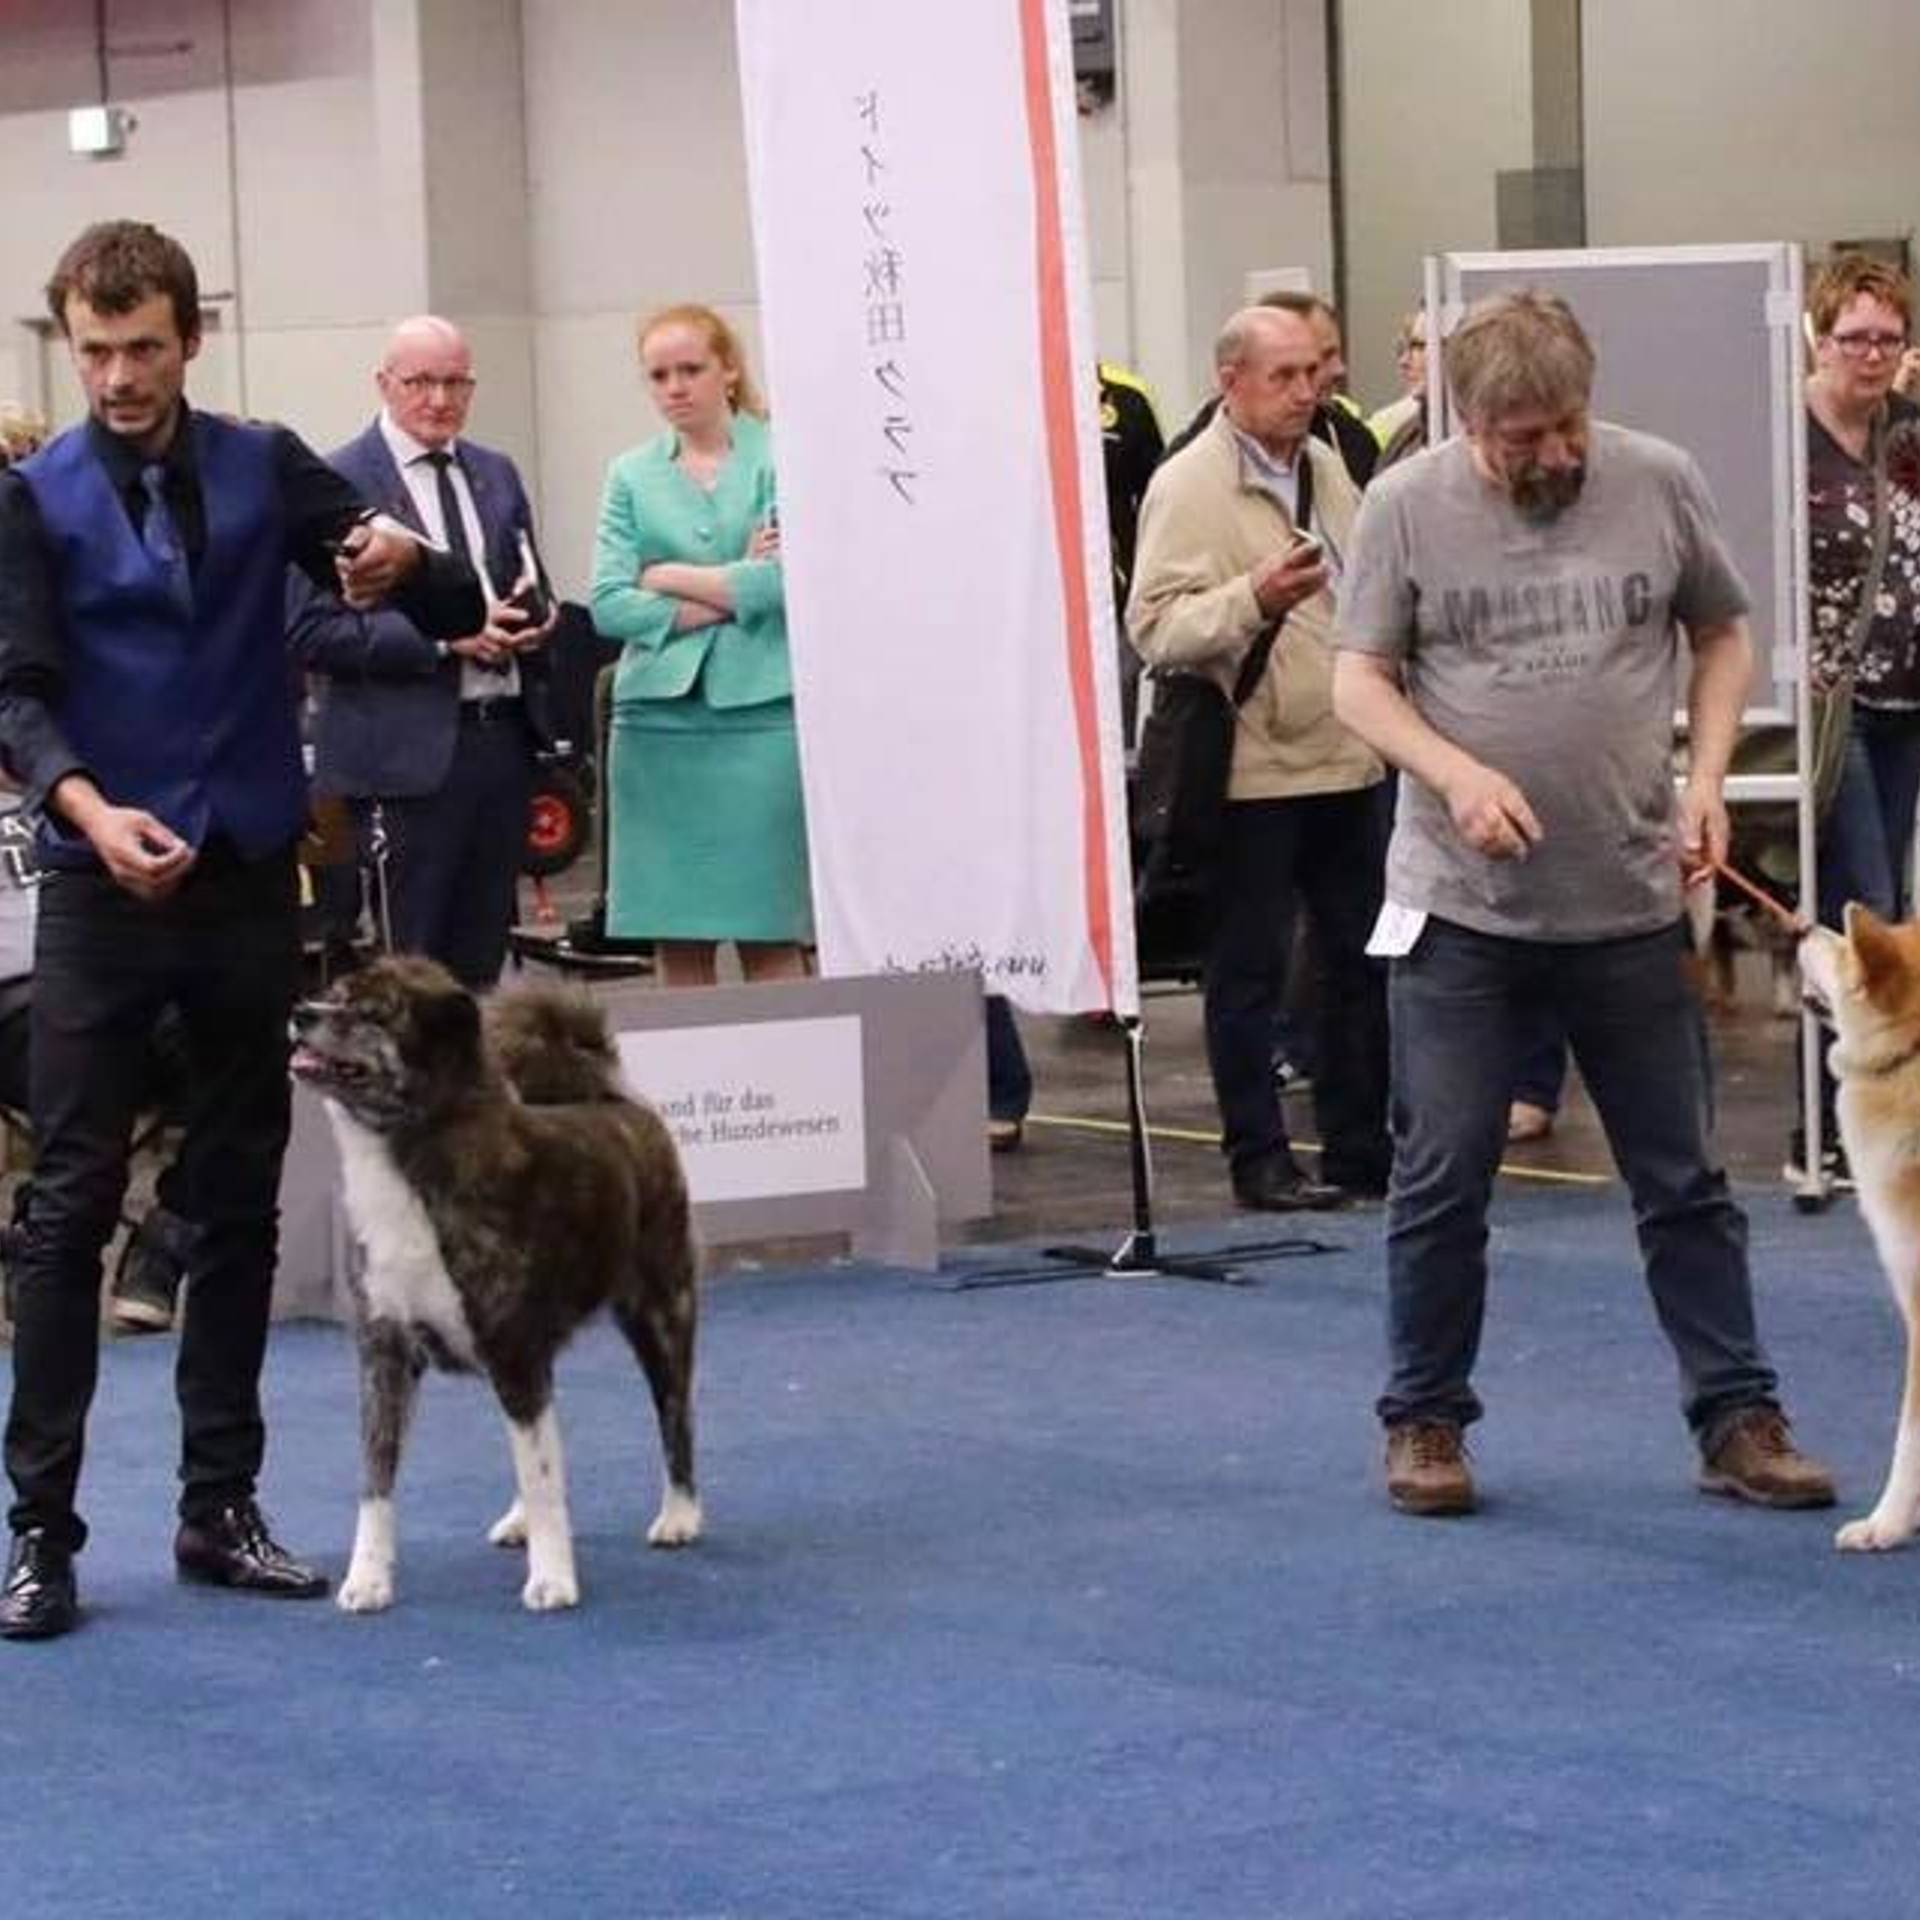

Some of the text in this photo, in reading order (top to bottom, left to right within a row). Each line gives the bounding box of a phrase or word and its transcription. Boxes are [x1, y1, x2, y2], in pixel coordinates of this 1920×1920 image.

[702, 1089, 734, 1120] für
[739, 1084, 775, 1110] das
[711, 1107, 840, 1143] Hundewesen
